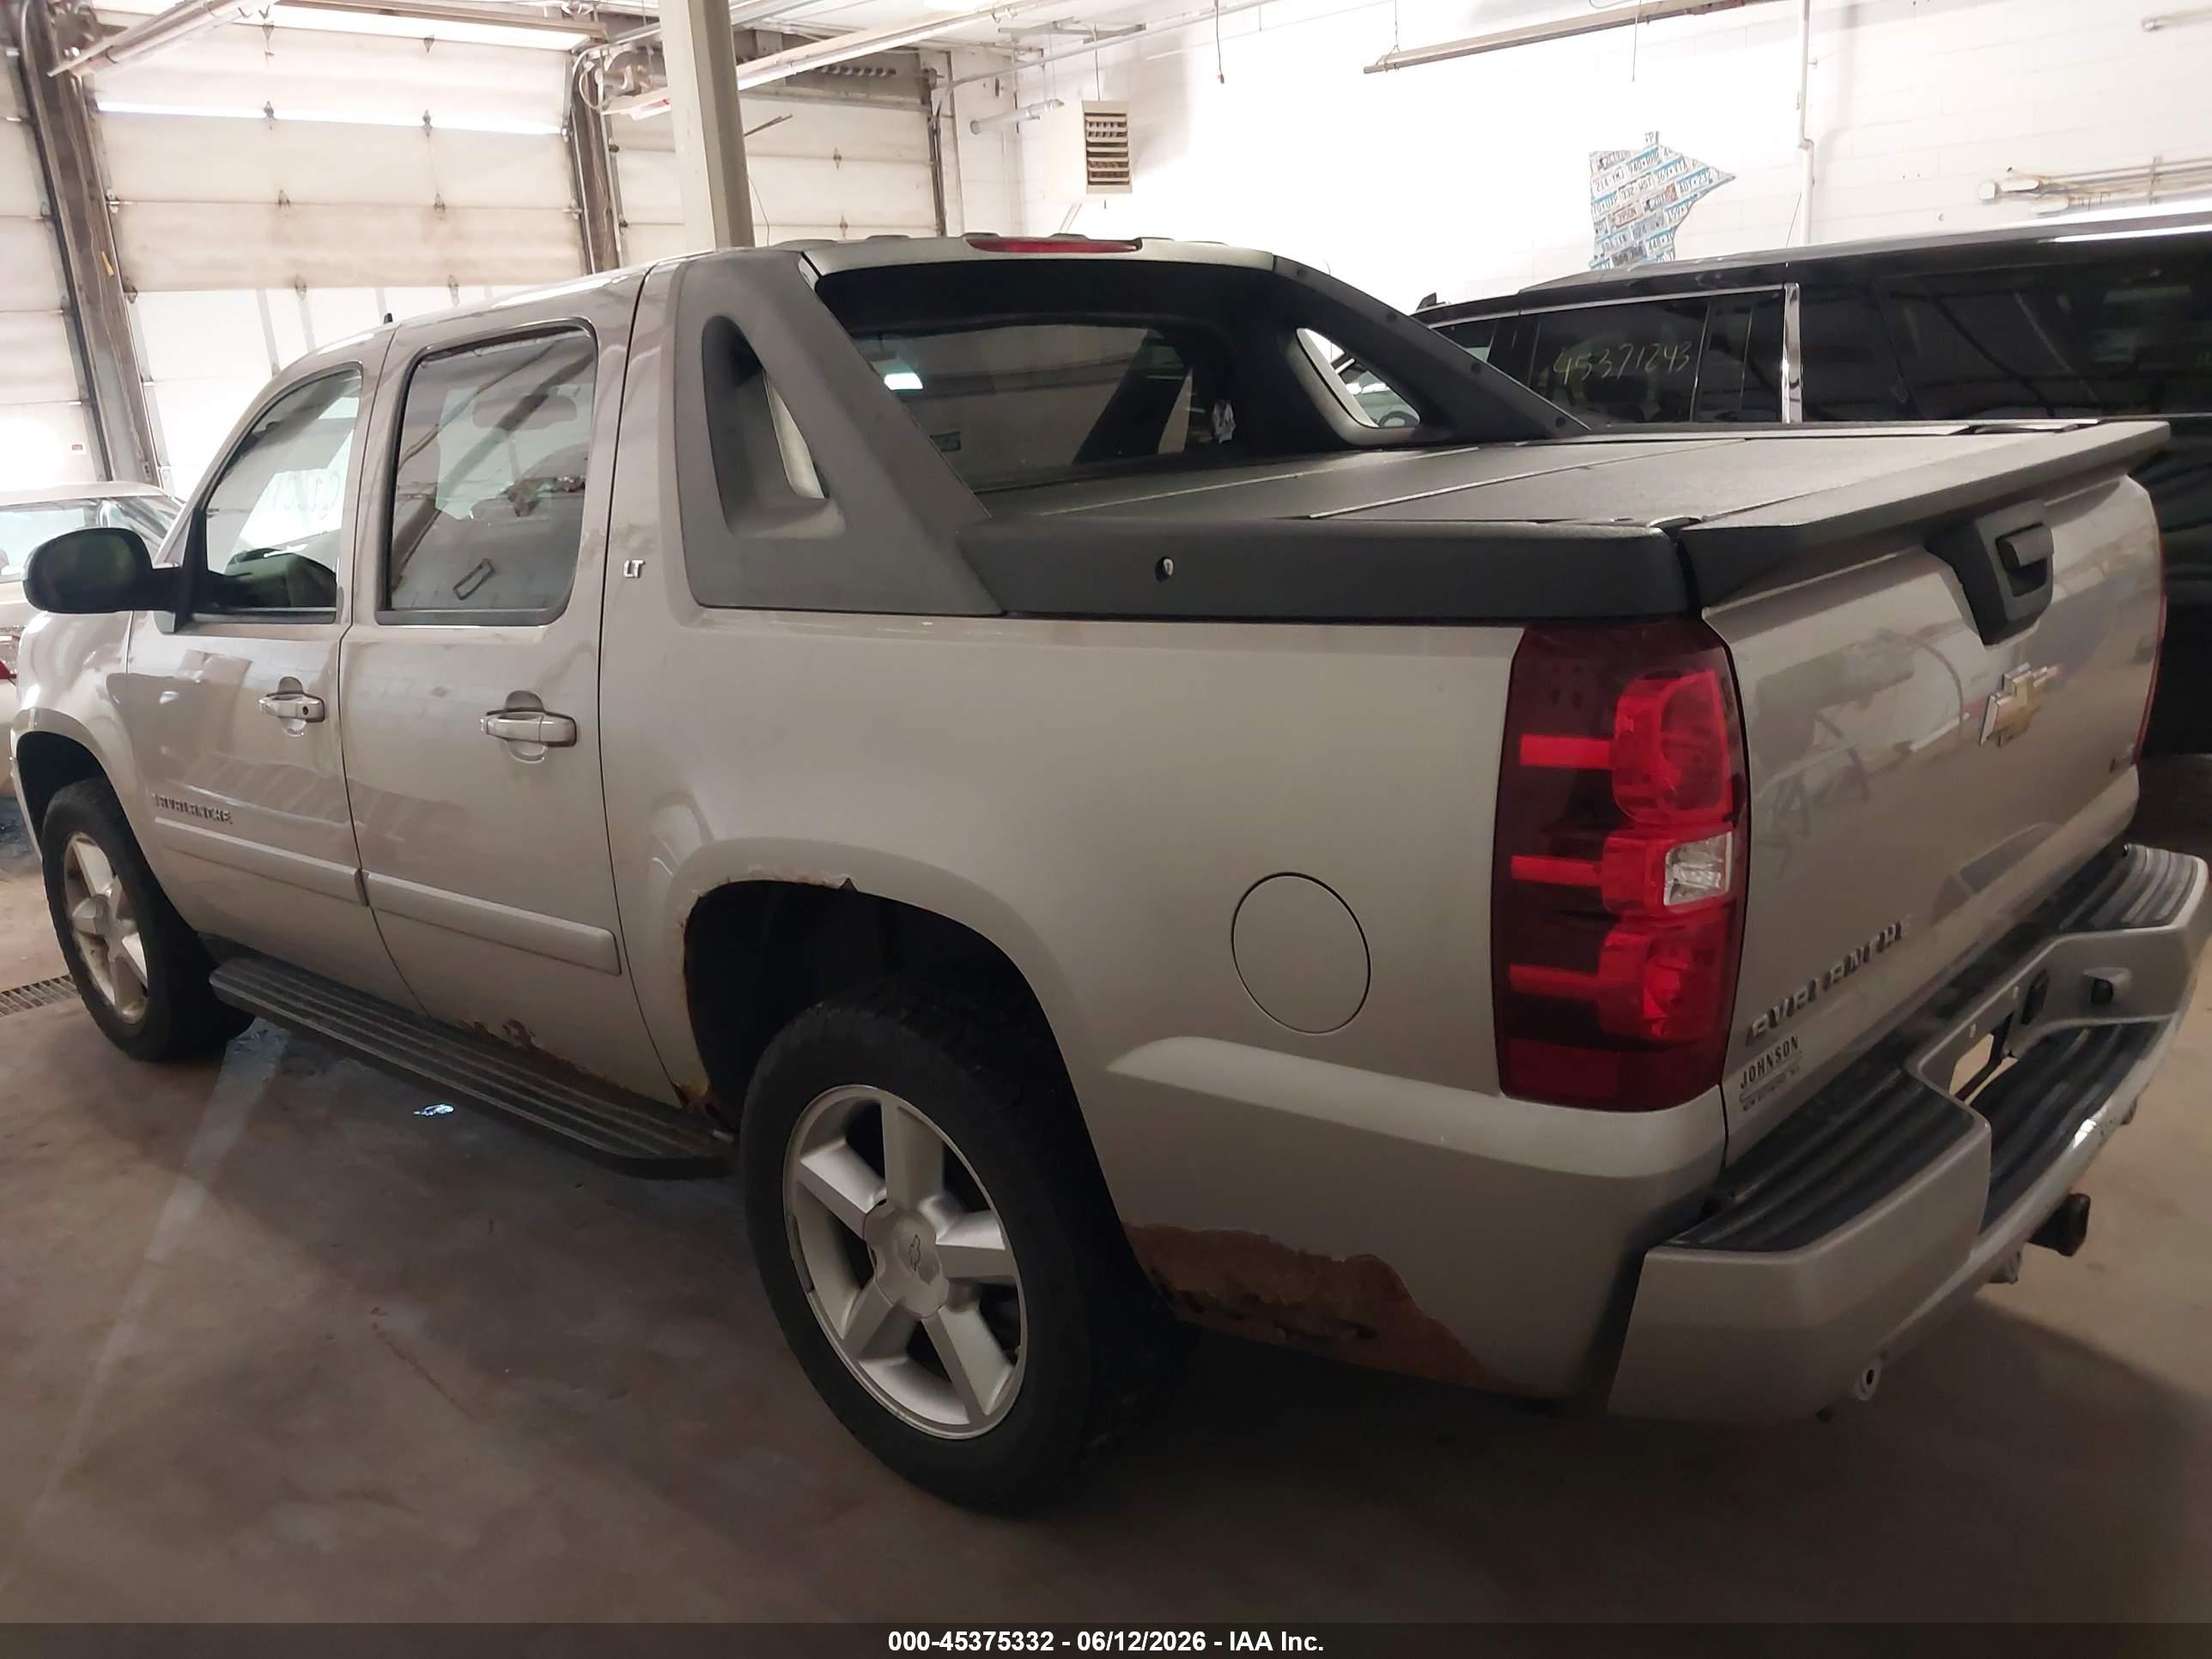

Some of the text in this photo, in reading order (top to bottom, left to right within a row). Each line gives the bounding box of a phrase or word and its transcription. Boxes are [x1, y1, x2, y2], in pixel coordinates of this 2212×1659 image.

[1553, 341, 1692, 385] 45371243
[623, 559, 646, 578] LT
[1739, 1036, 1800, 1090] JOHNSON
